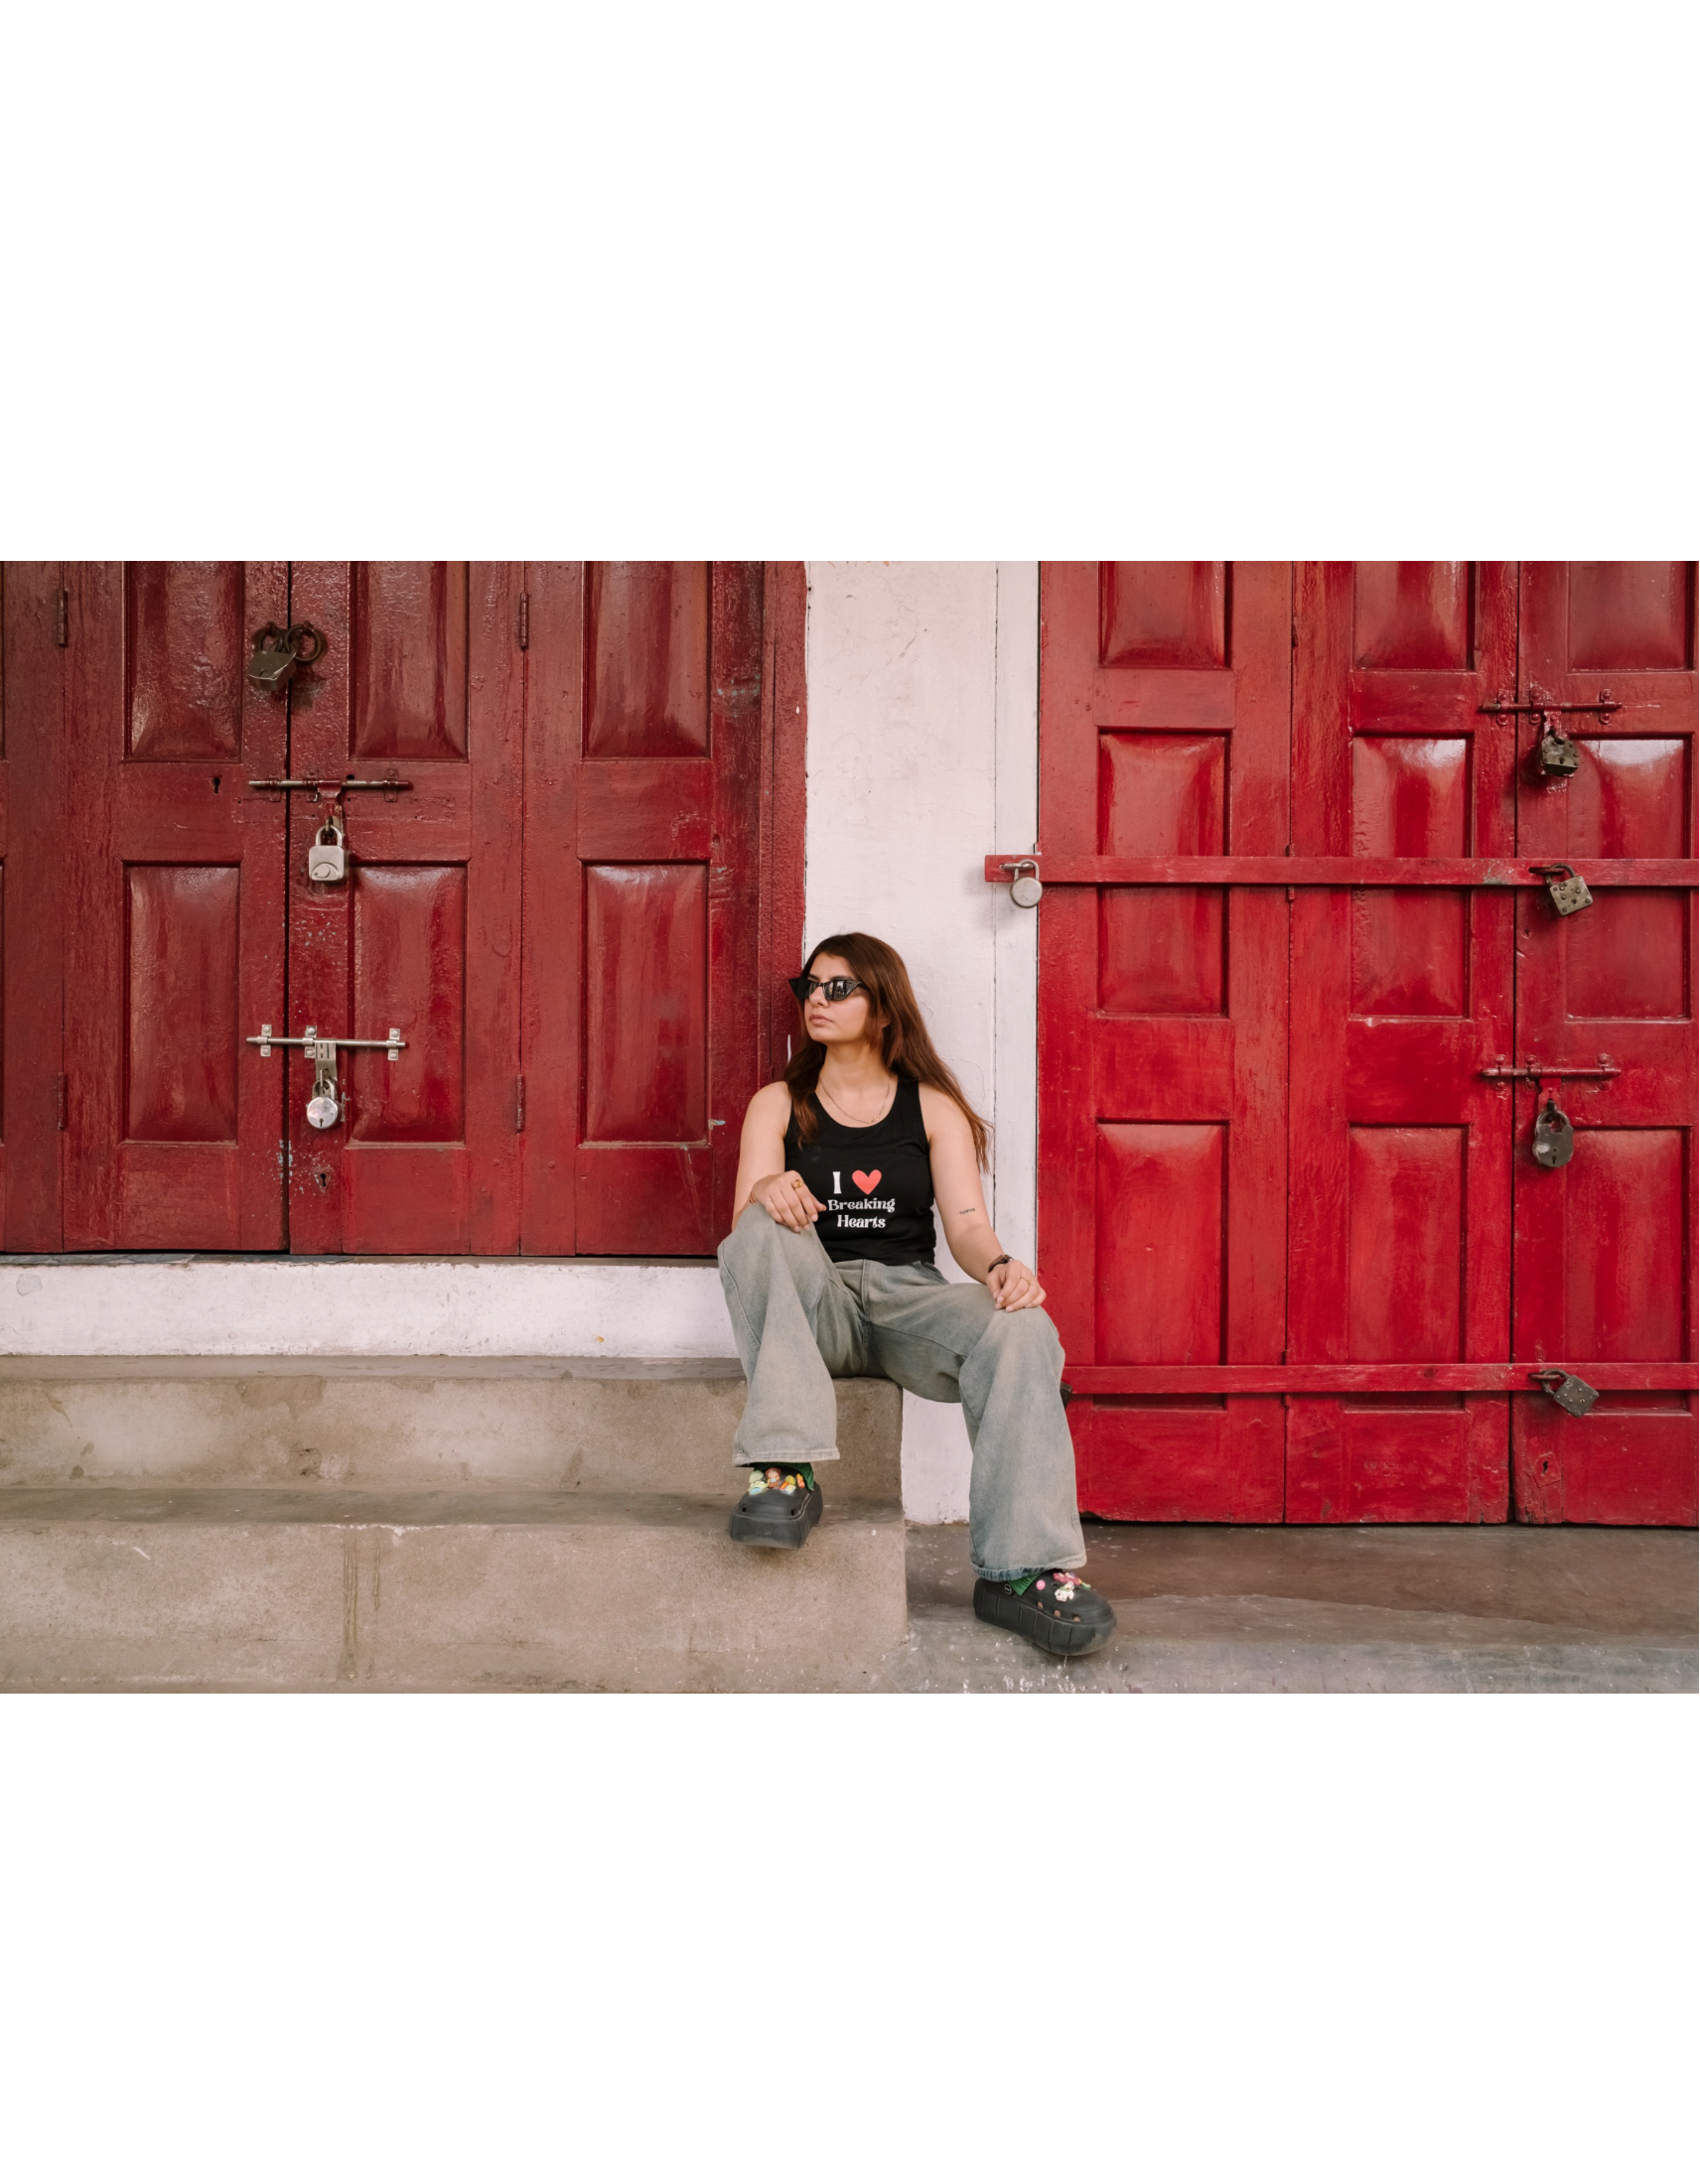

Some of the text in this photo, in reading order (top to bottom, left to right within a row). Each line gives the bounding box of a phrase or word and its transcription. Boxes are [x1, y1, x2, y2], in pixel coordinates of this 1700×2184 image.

[832, 1170, 842, 1194] I
[827, 1197, 896, 1213] Breaking
[836, 1214, 887, 1229] Hearts
